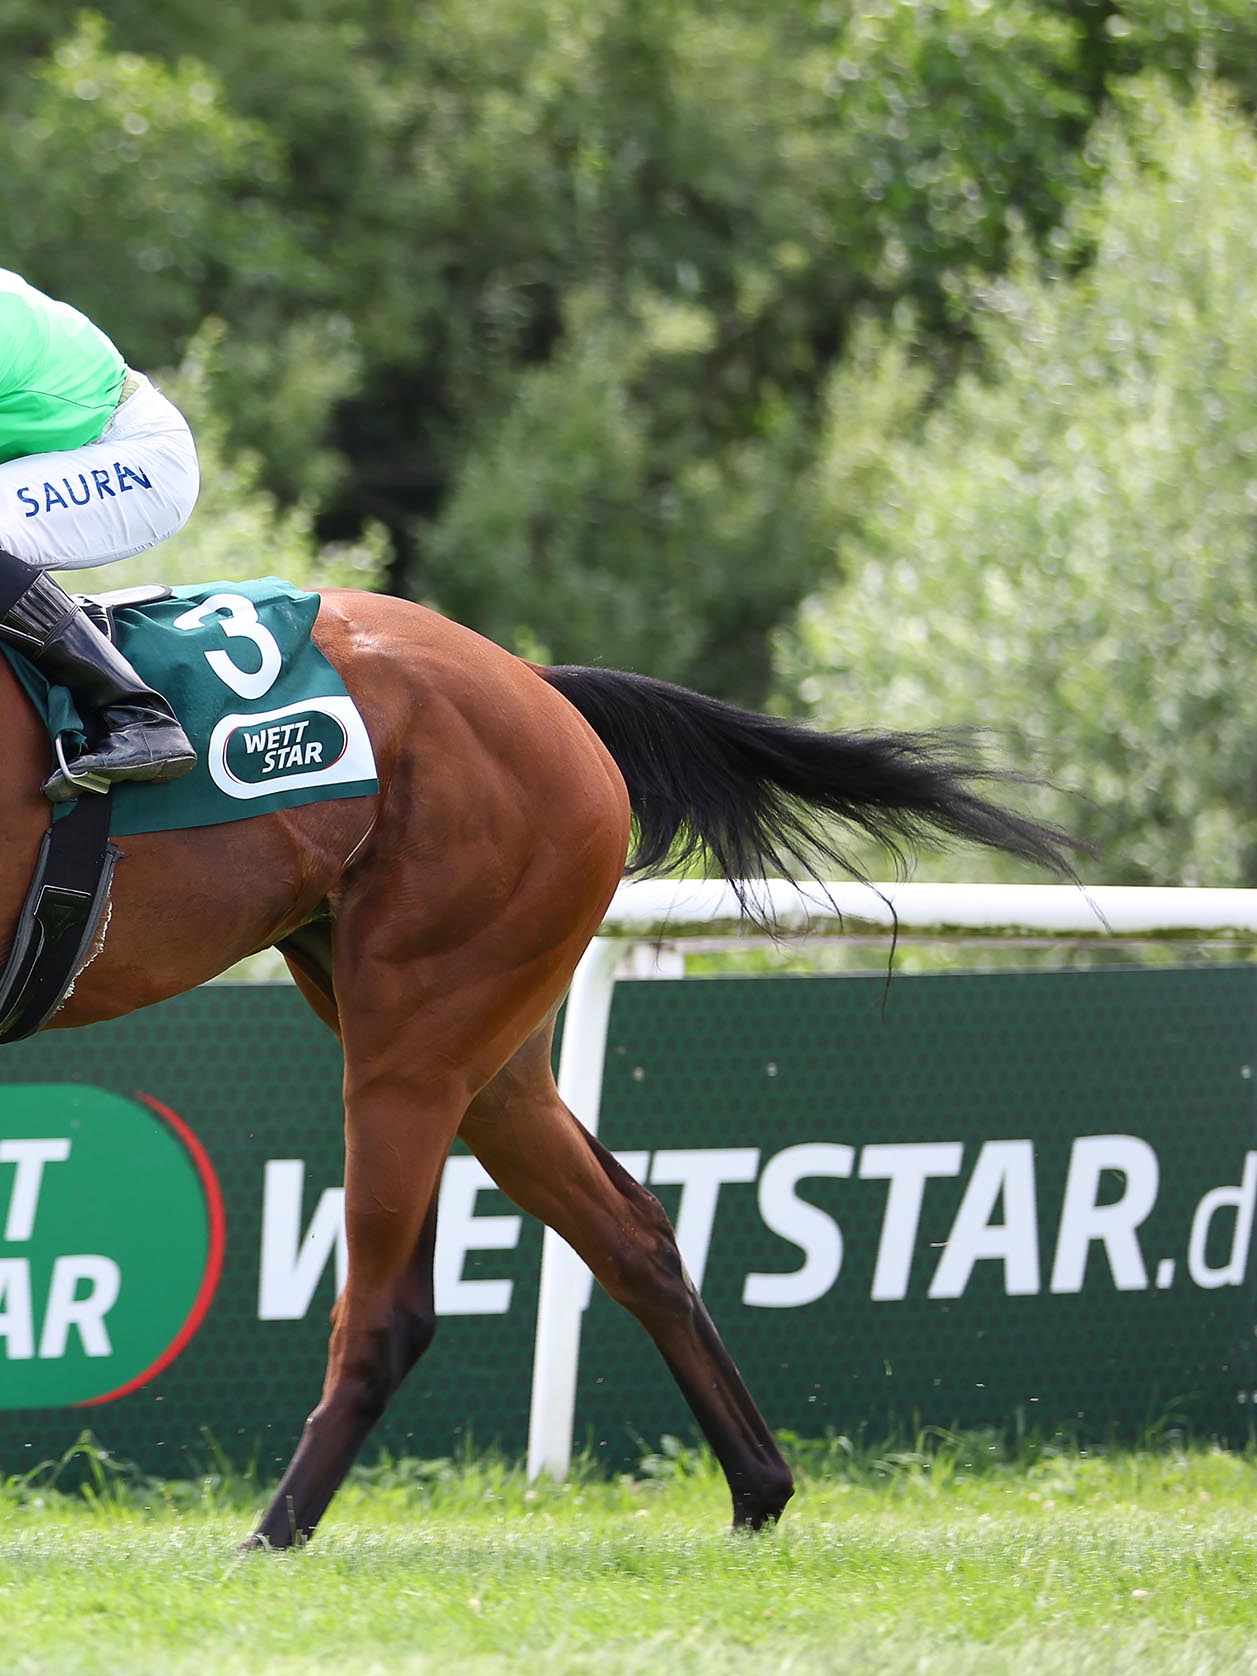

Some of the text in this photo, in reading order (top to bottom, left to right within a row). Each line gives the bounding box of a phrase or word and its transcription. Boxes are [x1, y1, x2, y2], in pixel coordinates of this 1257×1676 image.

[16, 462, 153, 518] SAUREN
[172, 592, 283, 700] 3
[243, 720, 310, 754] WETT
[261, 741, 323, 774] STAR
[257, 1134, 1257, 1321] WETSTAR.d
